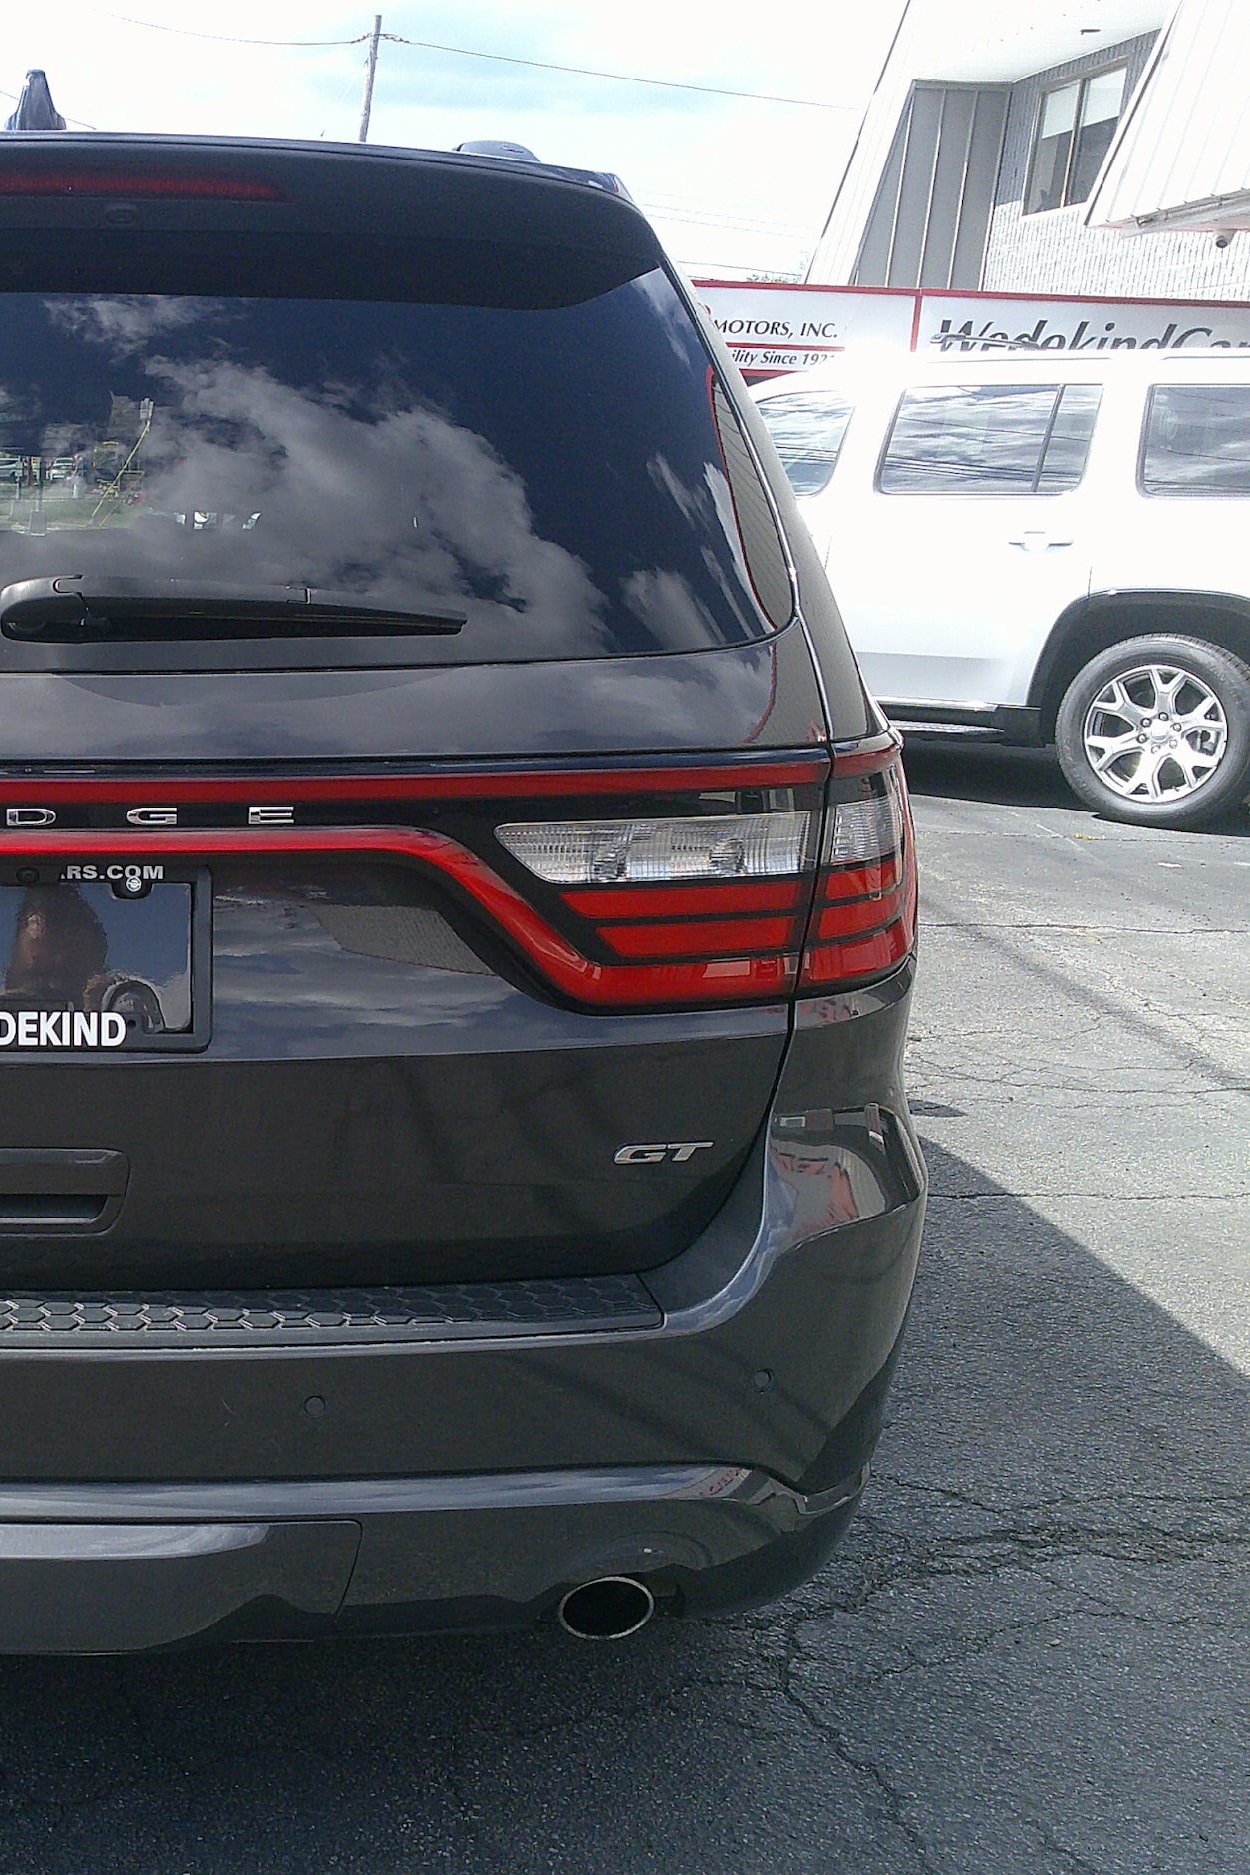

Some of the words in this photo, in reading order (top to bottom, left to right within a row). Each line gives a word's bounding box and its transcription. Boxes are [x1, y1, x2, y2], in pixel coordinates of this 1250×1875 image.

[714, 319, 794, 339] MOTORS,
[800, 322, 838, 338] INC.
[760, 351, 797, 365] Since
[614, 1141, 715, 1165] GT
